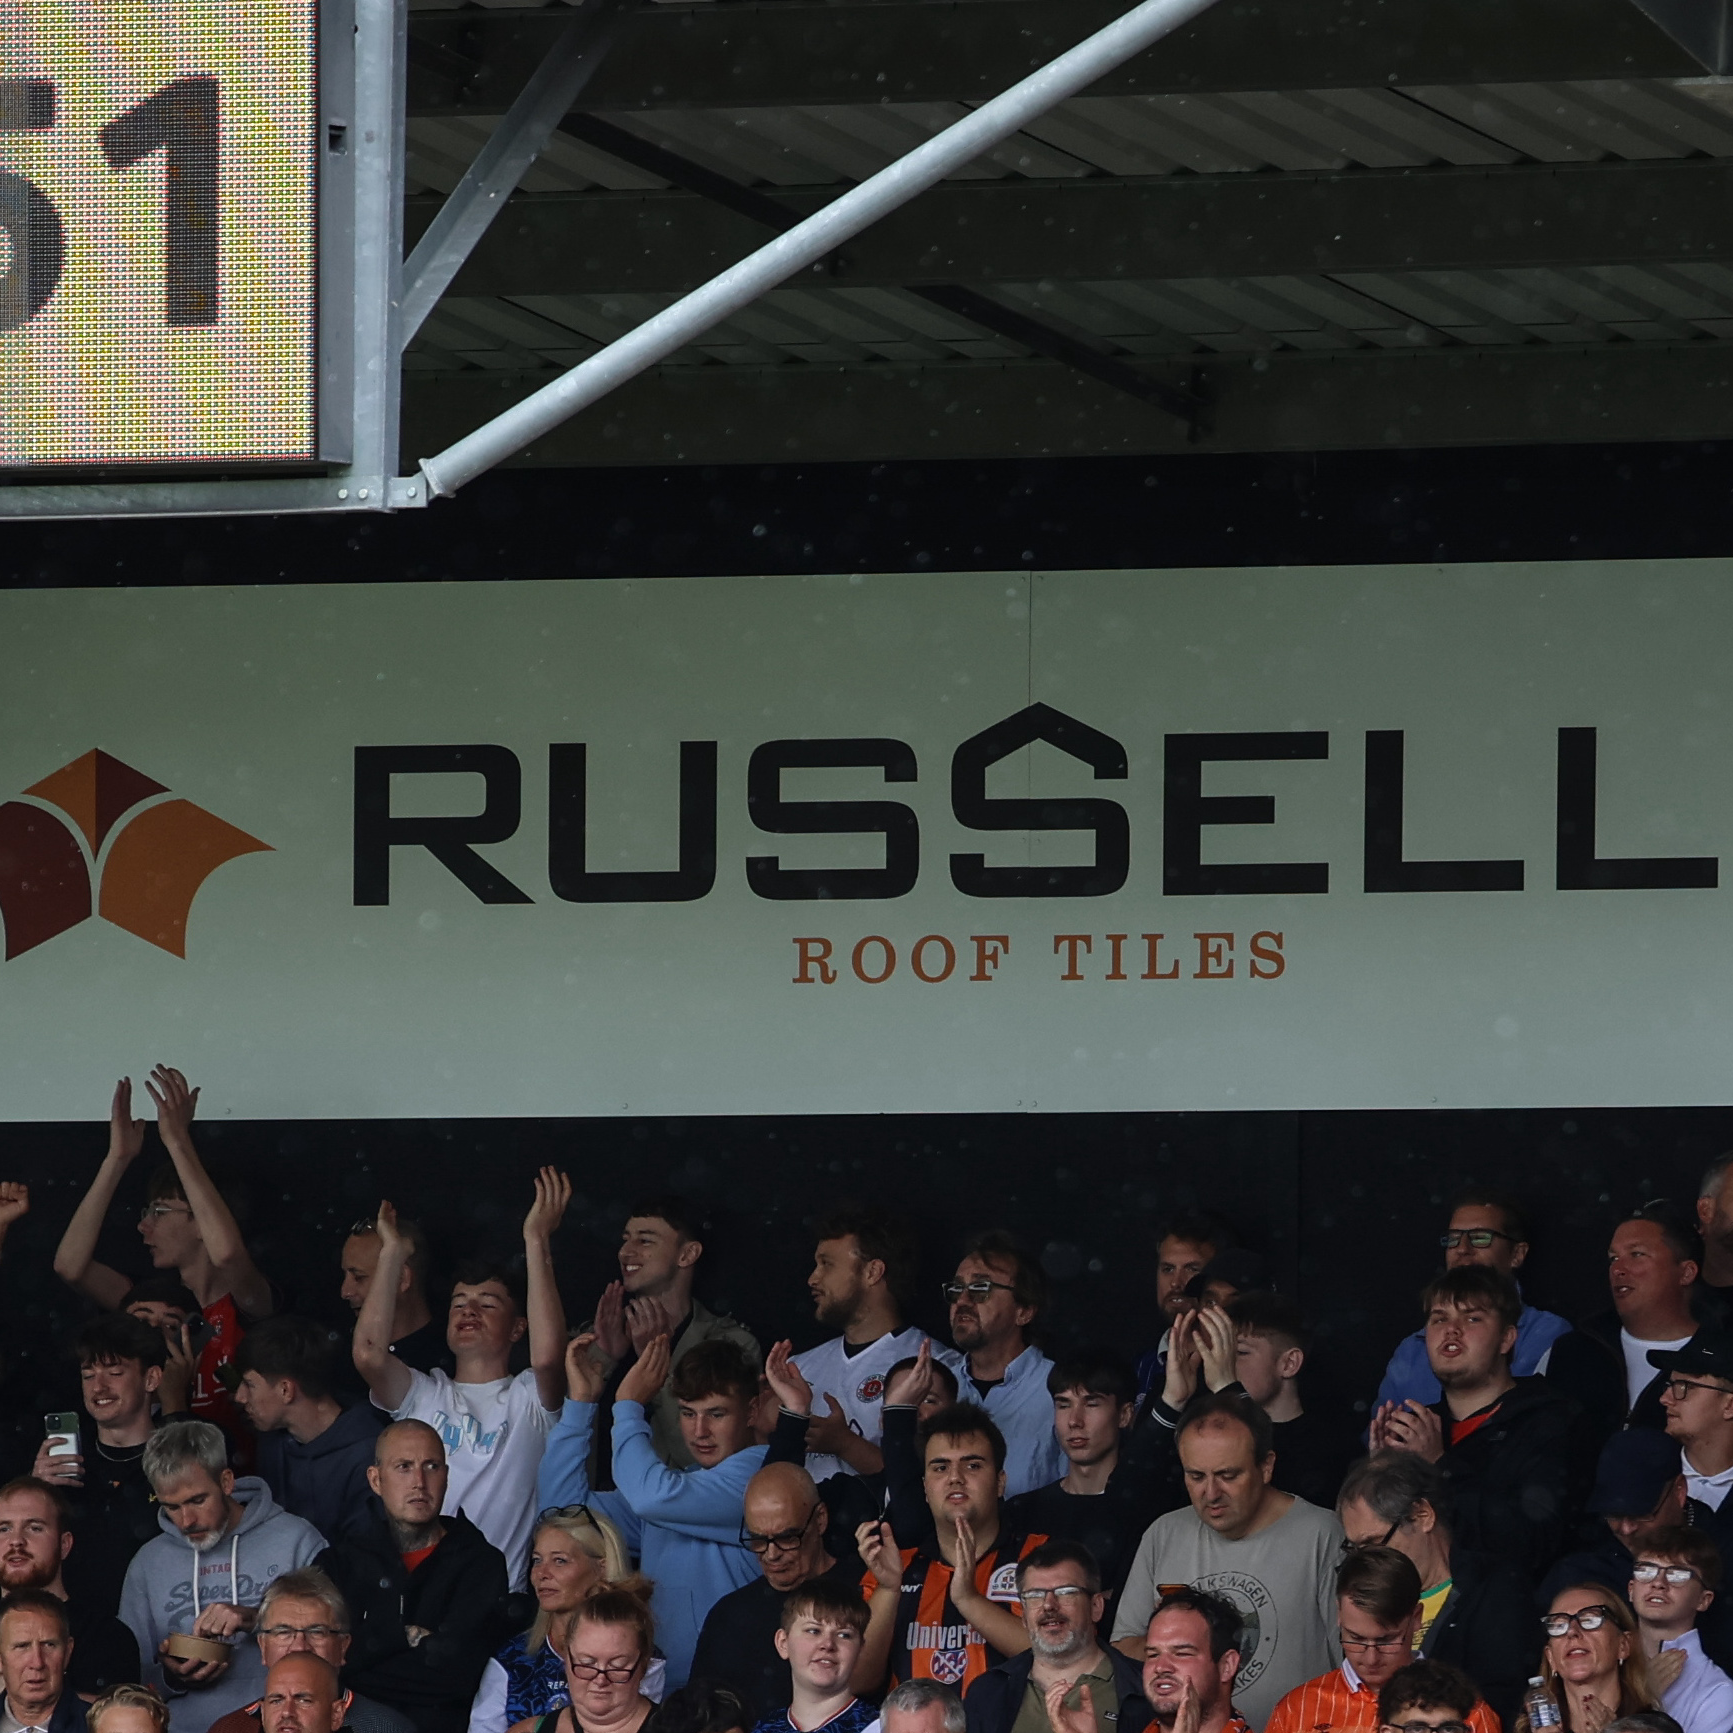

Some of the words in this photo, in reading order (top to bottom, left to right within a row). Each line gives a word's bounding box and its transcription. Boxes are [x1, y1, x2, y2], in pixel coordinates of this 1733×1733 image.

[354, 702, 1719, 907] RUSSELL
[793, 934, 1011, 985] ROOF
[1055, 930, 1286, 981] TILES
